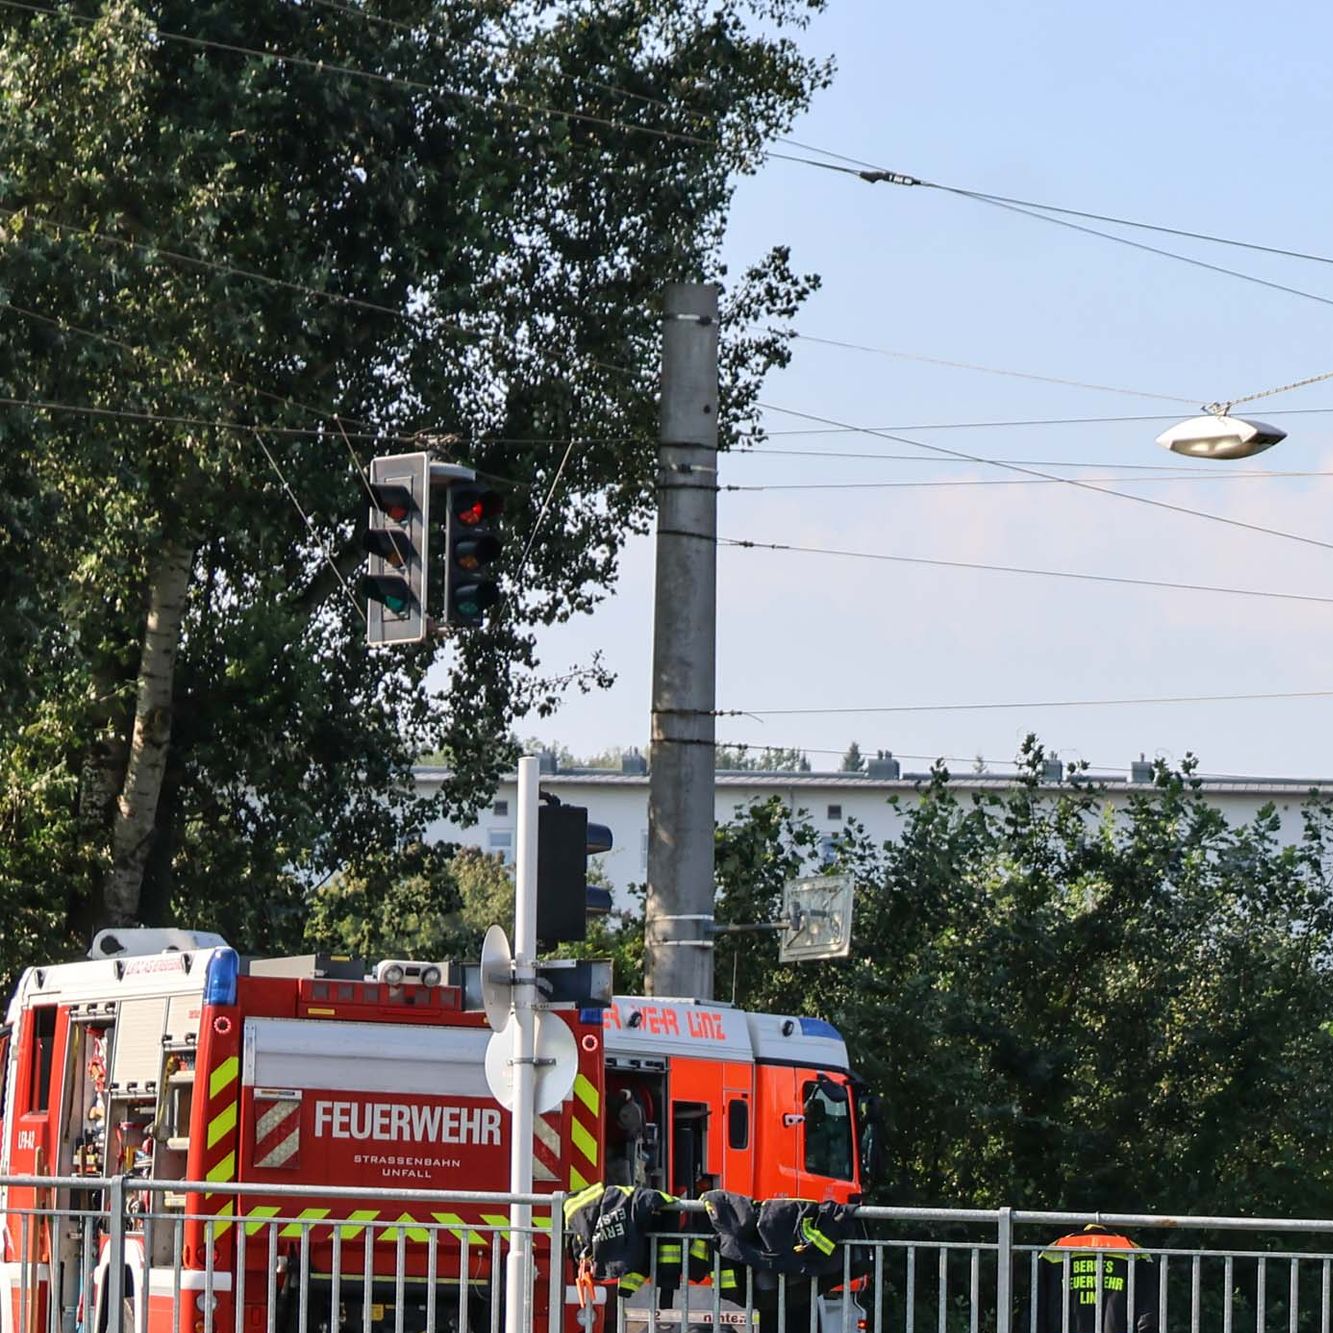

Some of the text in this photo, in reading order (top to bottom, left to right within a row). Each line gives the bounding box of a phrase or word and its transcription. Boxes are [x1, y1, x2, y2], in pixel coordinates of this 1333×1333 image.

[314, 1100, 501, 1146] FEUERWEHR
[353, 1154, 461, 1168] STRASSENBAHN
[382, 1168, 431, 1179] UNFALL
[1073, 1260, 1114, 1274] BERS
[1079, 1291, 1098, 1305] LIN
